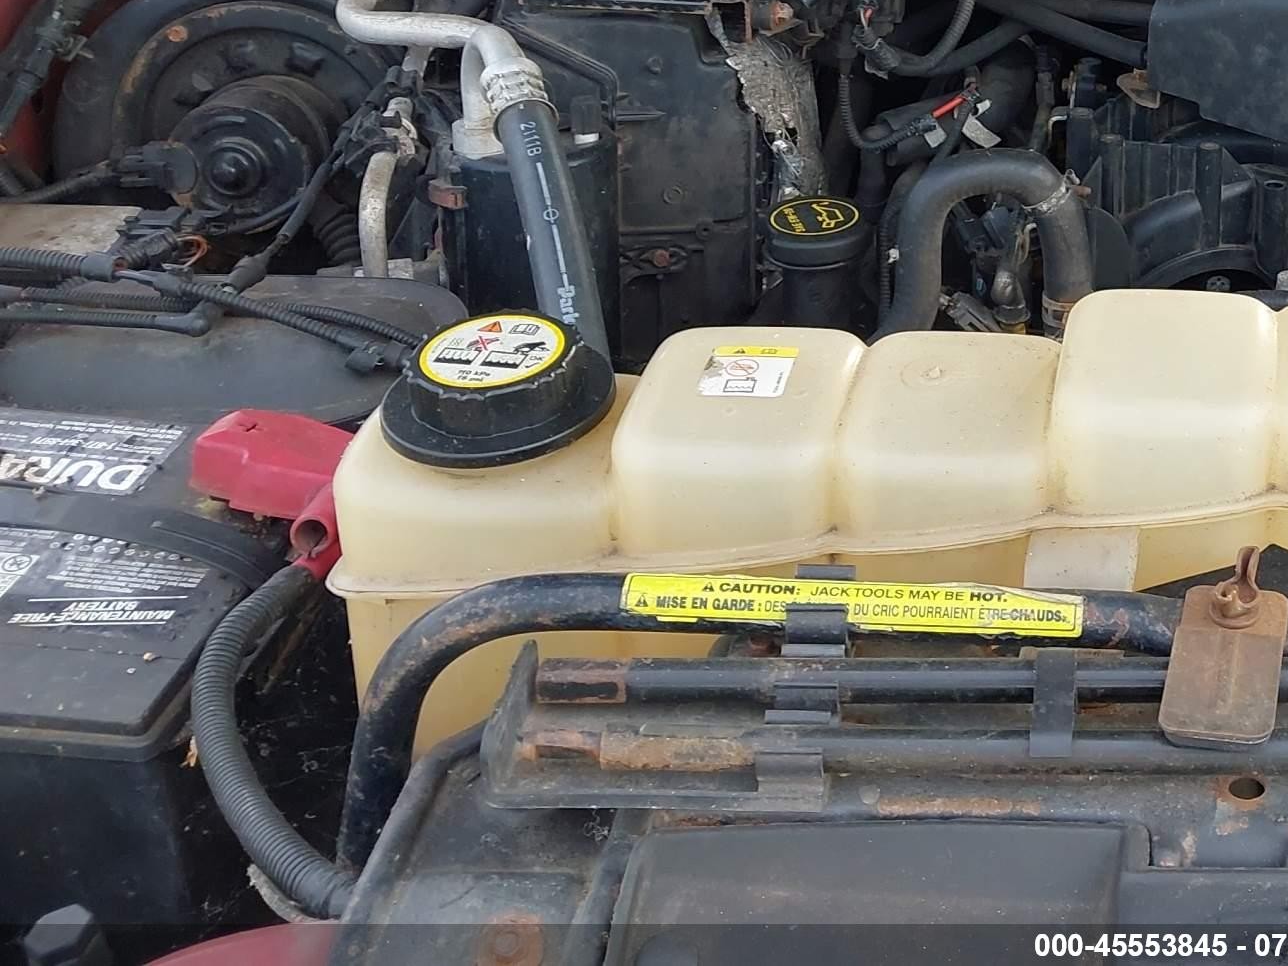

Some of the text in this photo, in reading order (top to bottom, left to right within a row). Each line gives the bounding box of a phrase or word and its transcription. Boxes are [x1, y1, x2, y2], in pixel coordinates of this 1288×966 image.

[719, 582, 1008, 603] CAUTION: JACK TOOLS MAY BE HOT.
[62, 600, 140, 612] BATTERY
[655, 596, 689, 610] MISE
[691, 597, 709, 611] EN
[712, 598, 756, 612] GARDE
[764, 600, 787, 614] DES
[853, 603, 870, 617] DU
[872, 603, 900, 618] CRIC
[902, 604, 976, 620] POURRAIENT
[7, 609, 177, 624] MAINTENANCE-FREE
